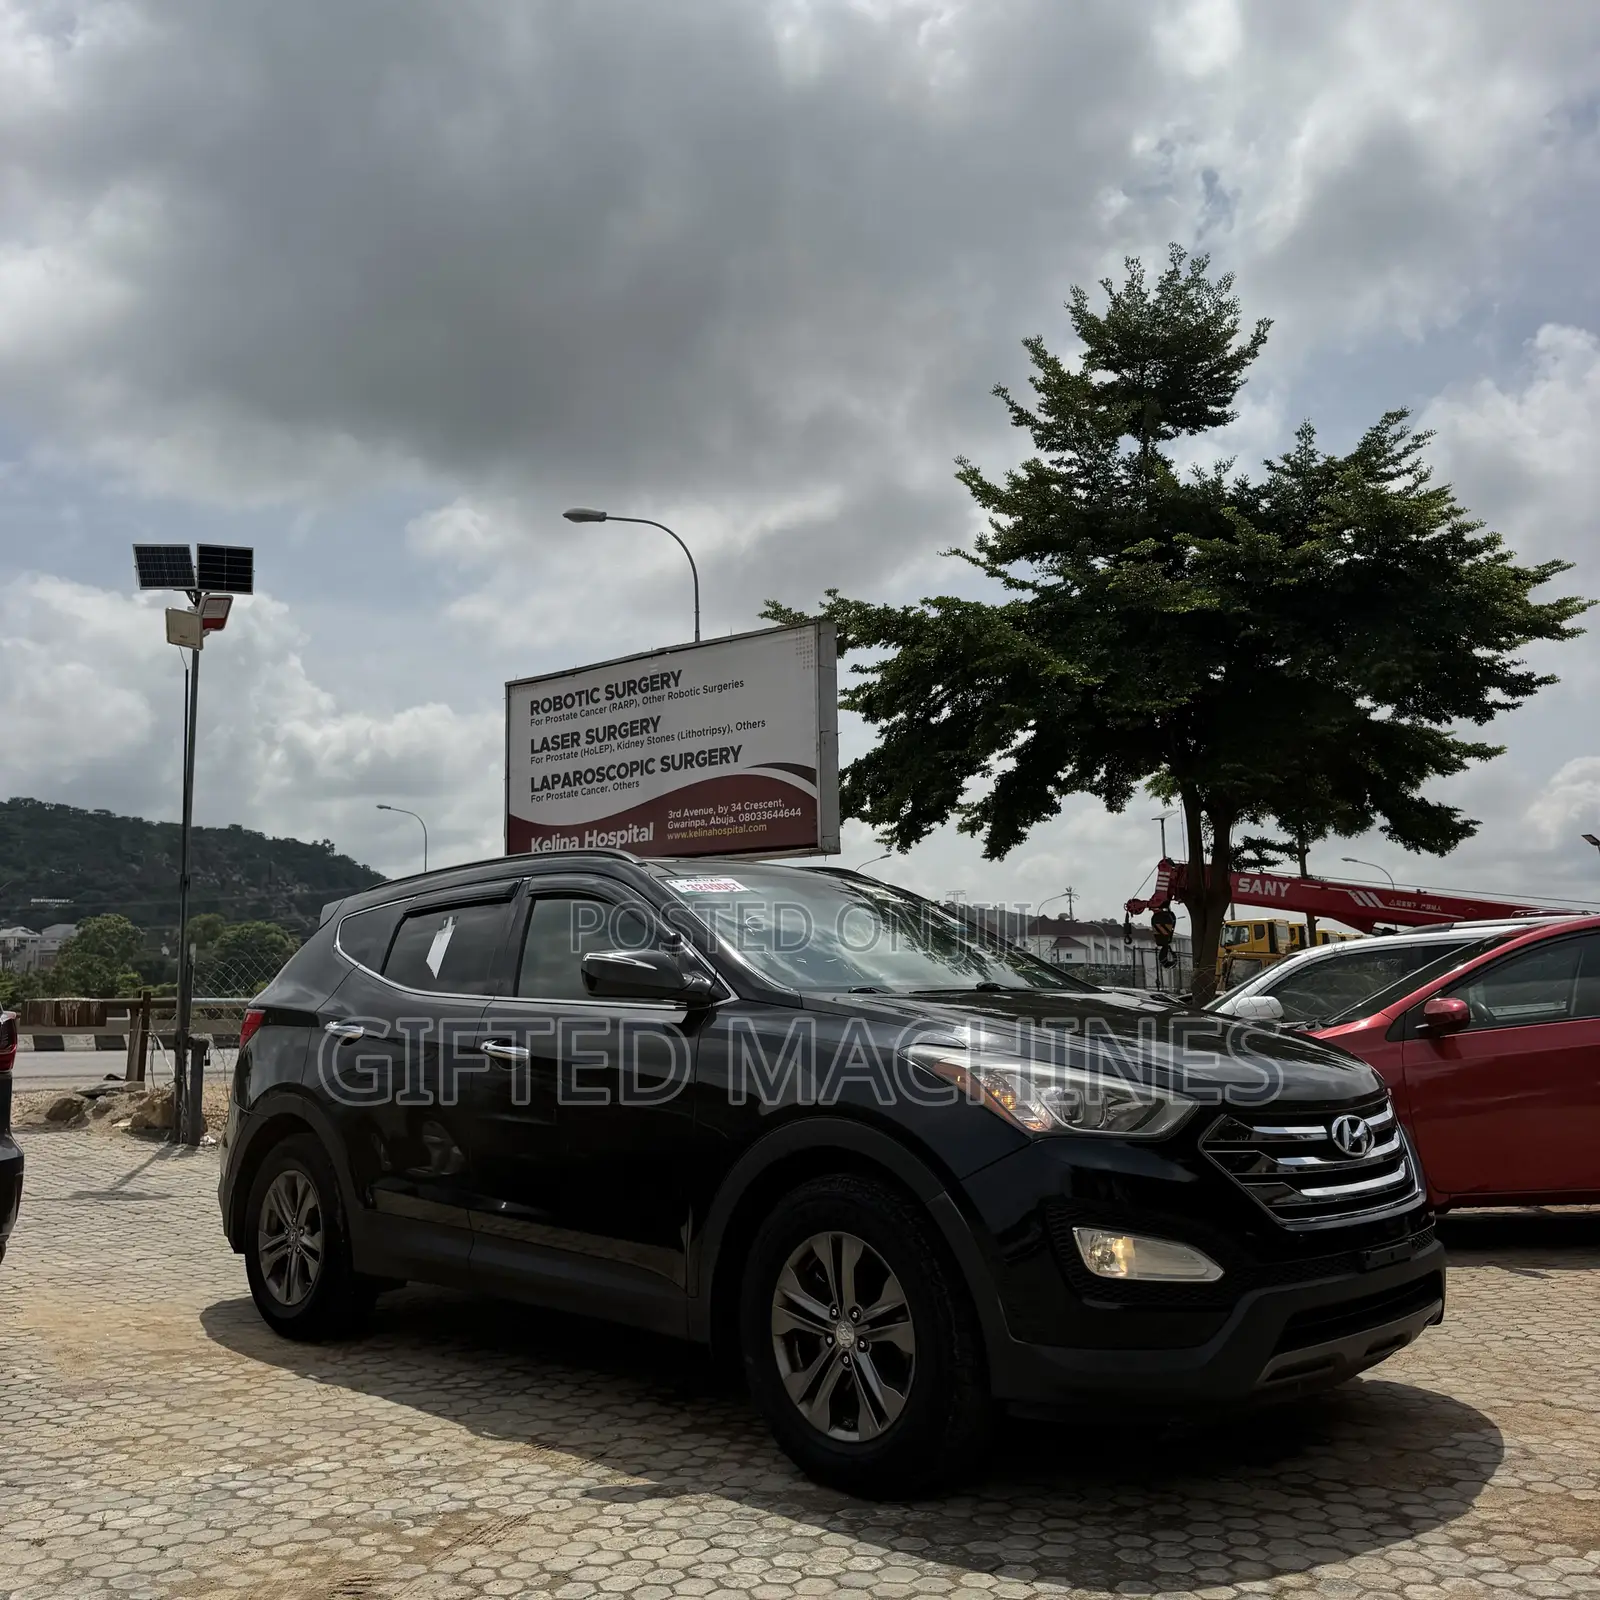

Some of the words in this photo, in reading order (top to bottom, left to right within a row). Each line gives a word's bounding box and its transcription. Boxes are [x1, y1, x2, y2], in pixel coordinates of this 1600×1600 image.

[530, 687, 601, 716] ROBOTIC
[604, 669, 683, 701] SURGERY
[530, 718, 543, 727] For
[545, 711, 578, 724] Prostate
[579, 706, 607, 718] Cancer
[609, 699, 640, 713] (RARP),
[642, 693, 666, 705] Other
[667, 687, 701, 700] Robotic
[702, 679, 745, 694] Surgeries
[530, 731, 581, 754] LASER
[585, 715, 661, 745] SURGERY
[530, 756, 543, 765] For
[545, 750, 579, 762] Prostate
[580, 743, 615, 758] (HoLEP),
[616, 739, 645, 750] Kidney
[647, 734, 676, 745] Stones
[677, 723, 733, 741] (Lithotripsy),
[735, 719, 766, 731] Others
[530, 757, 656, 793] LAPAROSCOPIC
[660, 744, 743, 773] SURGERY
[530, 794, 544, 803] For
[546, 787, 579, 800] Prostate
[612, 780, 640, 791] Others
[667, 809, 682, 819] 3rd
[683, 805, 716, 817] Avenue,
[717, 804, 728, 814] by
[730, 802, 742, 812] 34
[743, 798, 785, 810] Crescent,
[667, 818, 708, 830] Gwarinpa,
[738, 807, 802, 822] 08033644644
[531, 833, 580, 853] Kelina
[584, 821, 655, 849] Hospital
[667, 823, 768, 840] www.kelinahospital.com
[1237, 877, 1291, 898] SANY
